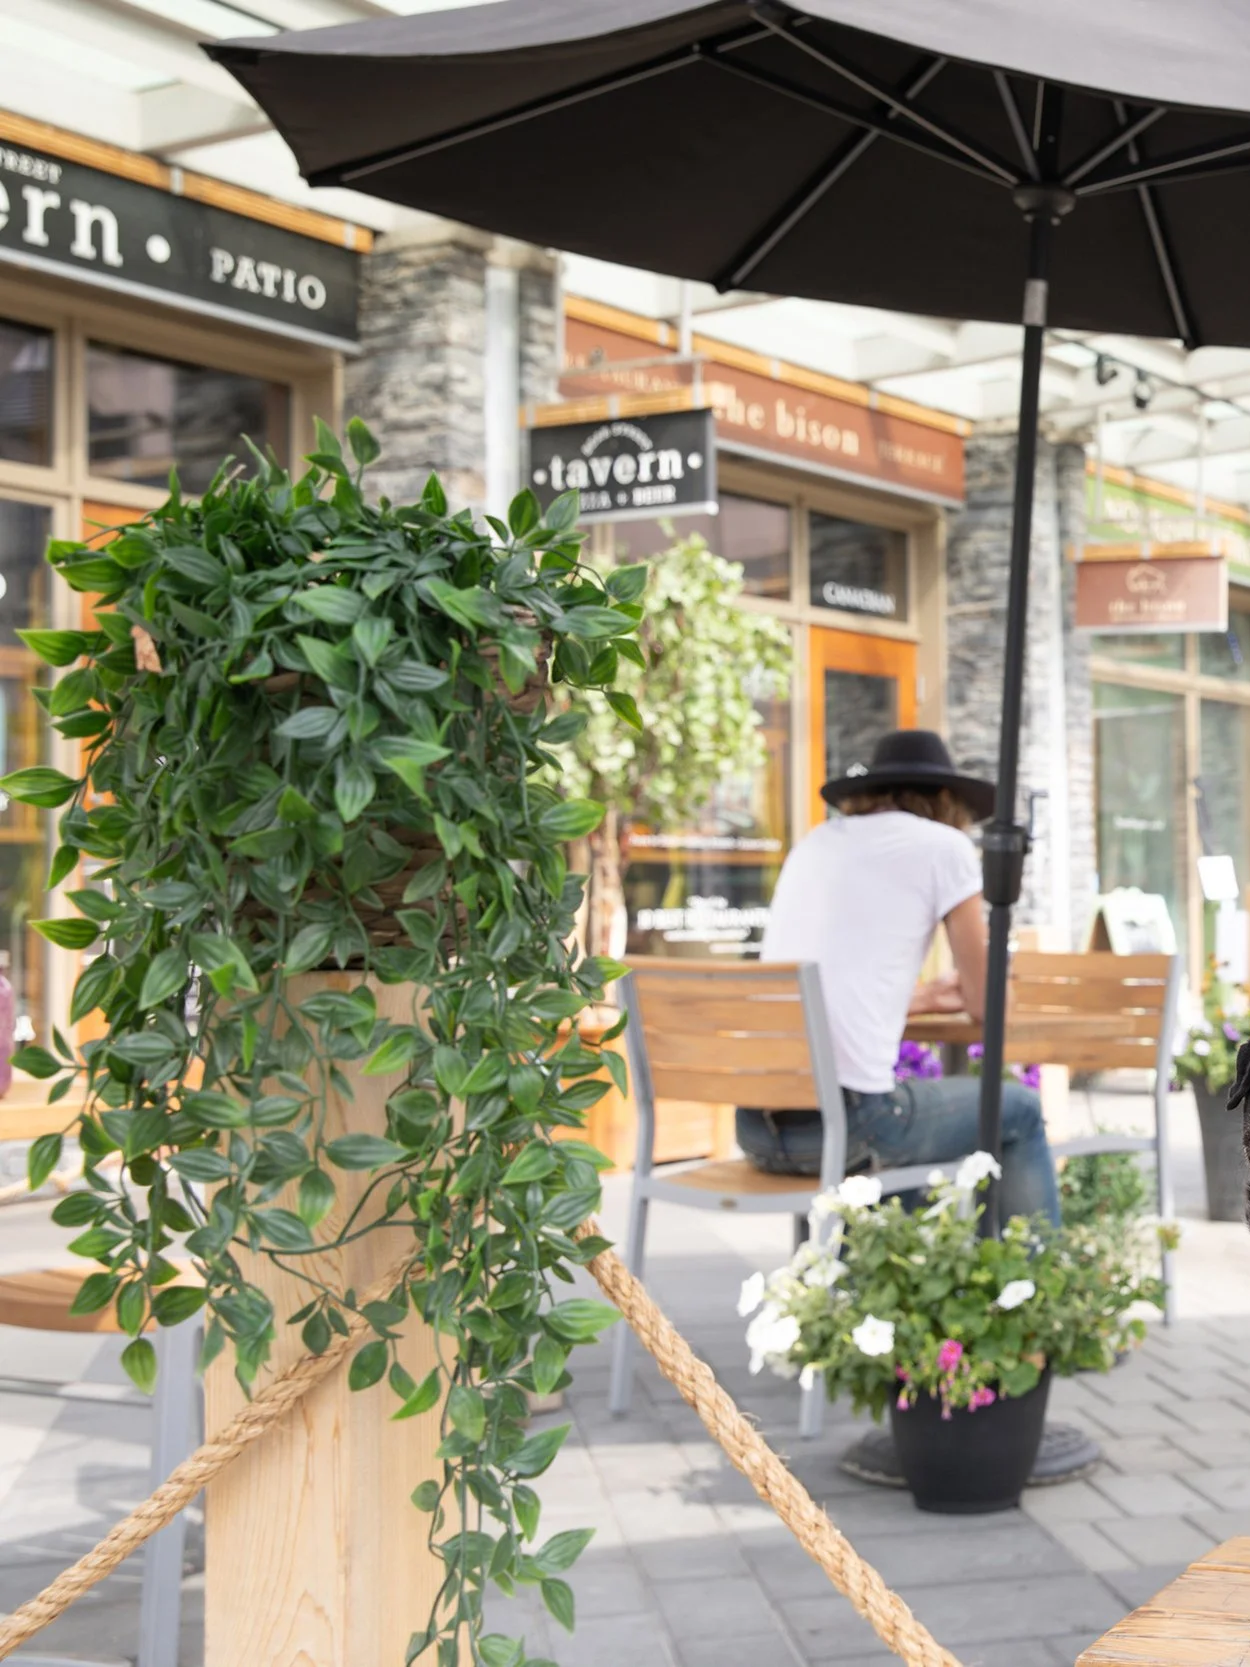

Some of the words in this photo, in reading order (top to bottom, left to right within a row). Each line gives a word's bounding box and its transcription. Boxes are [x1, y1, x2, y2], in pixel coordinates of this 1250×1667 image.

[0, 179, 123, 267] rn
[209, 247, 327, 310] PATIO
[775, 399, 859, 456] bison
[549, 449, 685, 492] tavern
